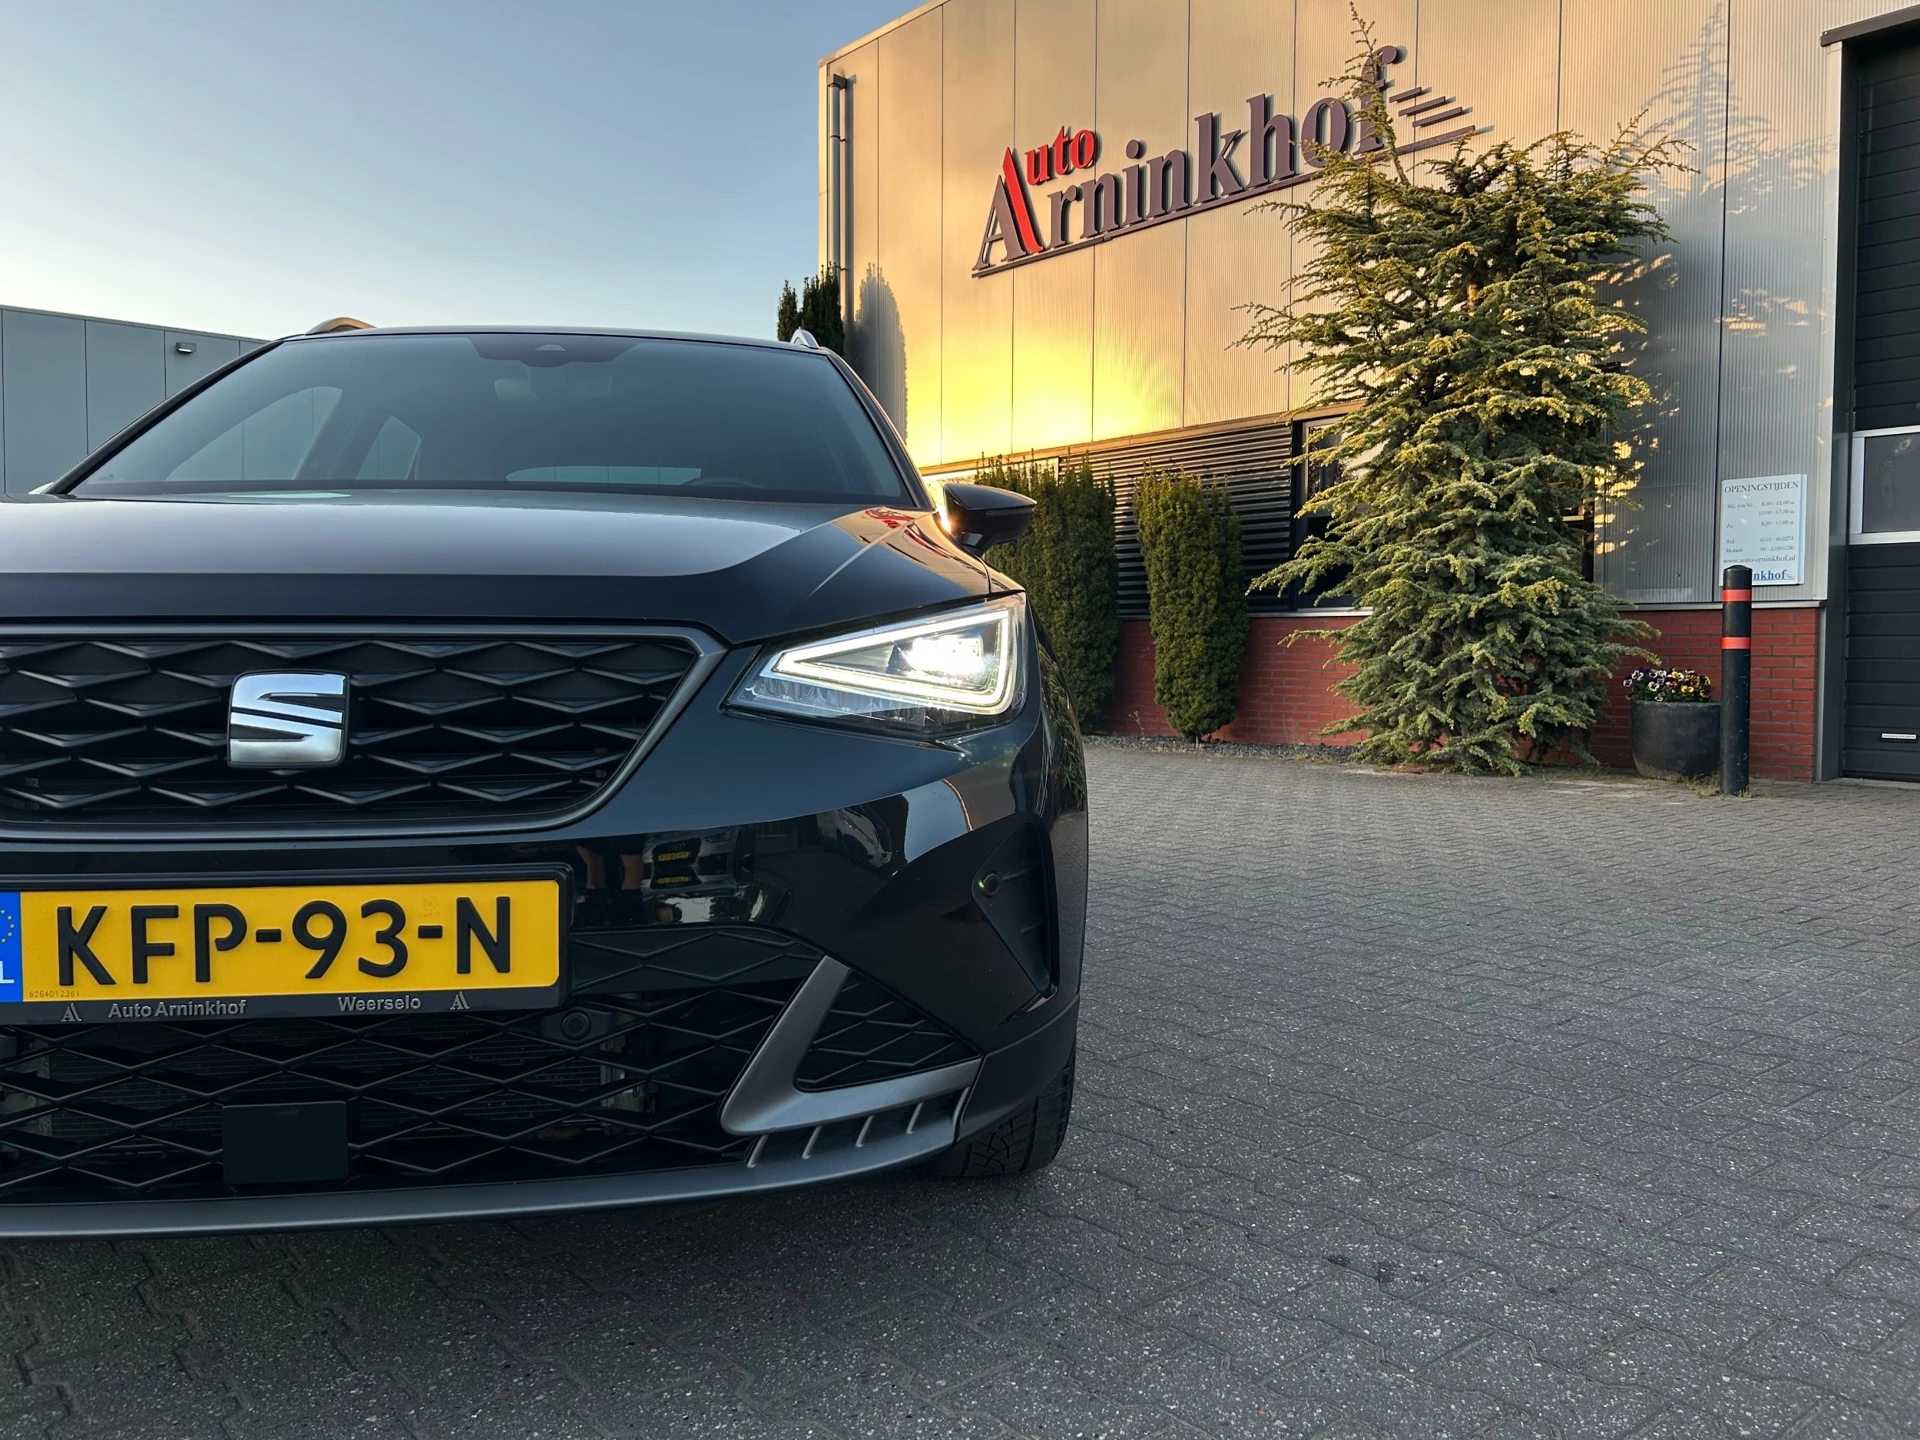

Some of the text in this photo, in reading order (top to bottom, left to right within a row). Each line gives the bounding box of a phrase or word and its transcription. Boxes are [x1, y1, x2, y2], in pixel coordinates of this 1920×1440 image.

[971, 44, 1398, 272] Arninkhof
[1724, 481, 1799, 493] OPENINGSTIJDEN
[1753, 569, 1787, 581] nkhof
[57, 896, 511, 986] KFP-93-N
[0, 960, 15, 984] L
[29, 989, 80, 999] 6264012361
[108, 1003, 152, 1018] Auto
[155, 1000, 247, 1017] Arninkhof
[338, 994, 422, 1011] Weerselo
